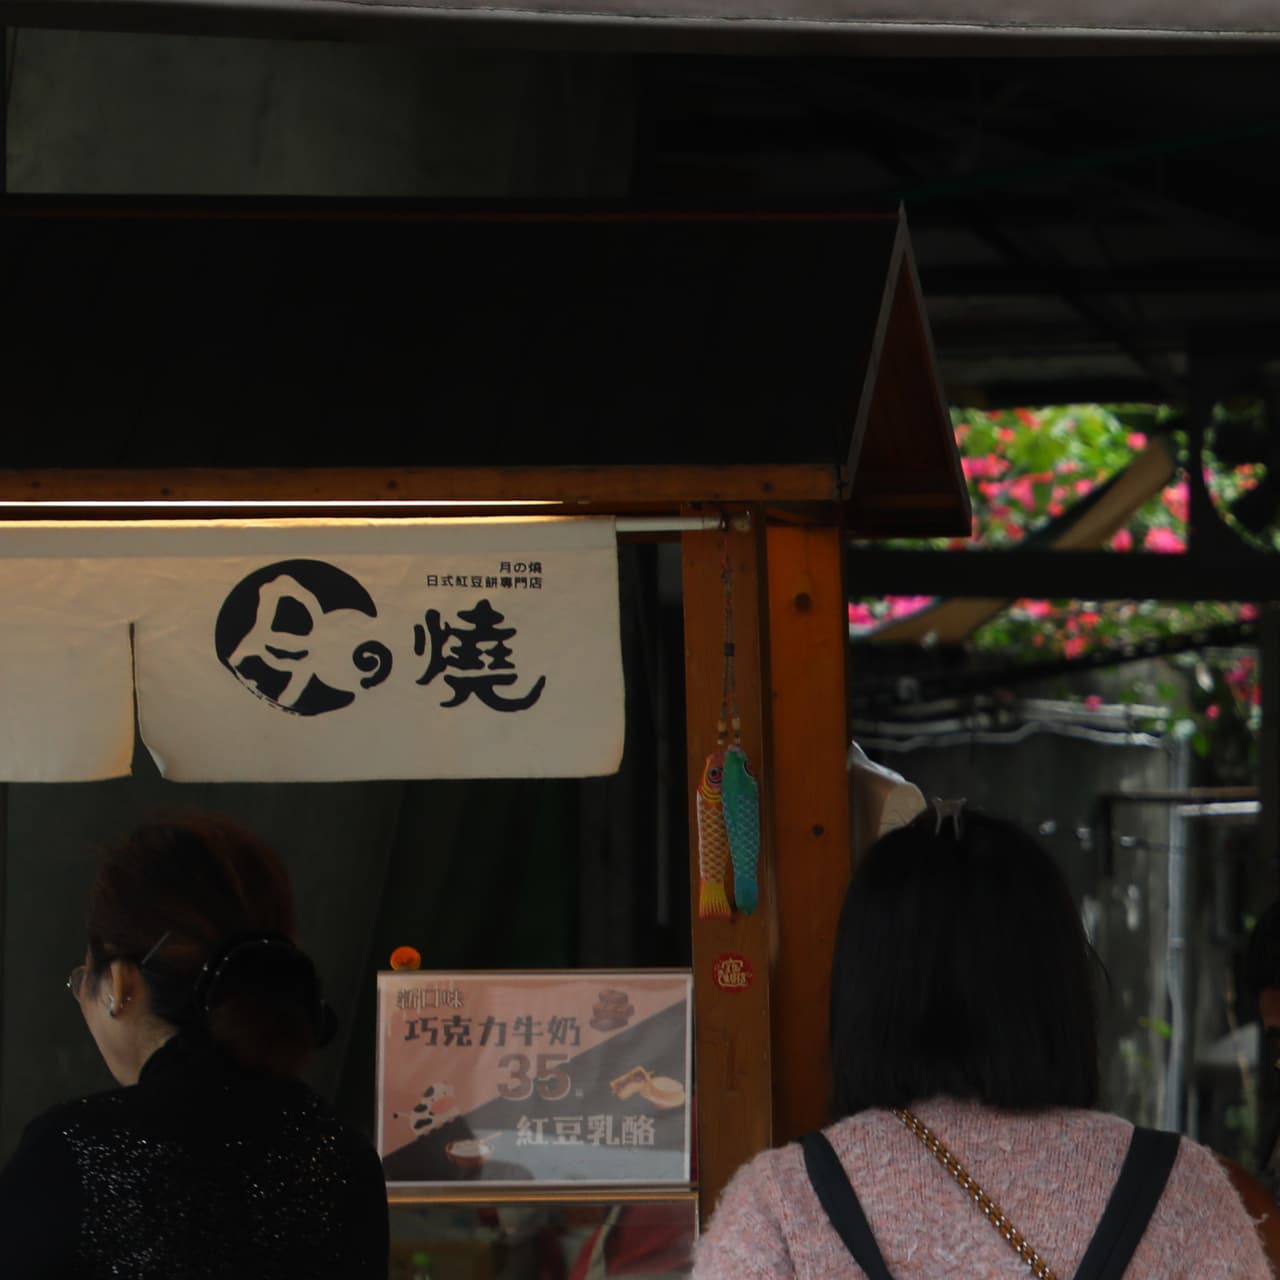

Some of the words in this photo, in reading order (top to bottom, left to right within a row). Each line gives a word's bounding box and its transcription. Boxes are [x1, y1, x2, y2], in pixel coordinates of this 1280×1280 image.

[404, 1015, 581, 1047] 巧克力牛奶
[496, 1052, 571, 1100] 35
[515, 1115, 657, 1147] 紅豆乳酪
